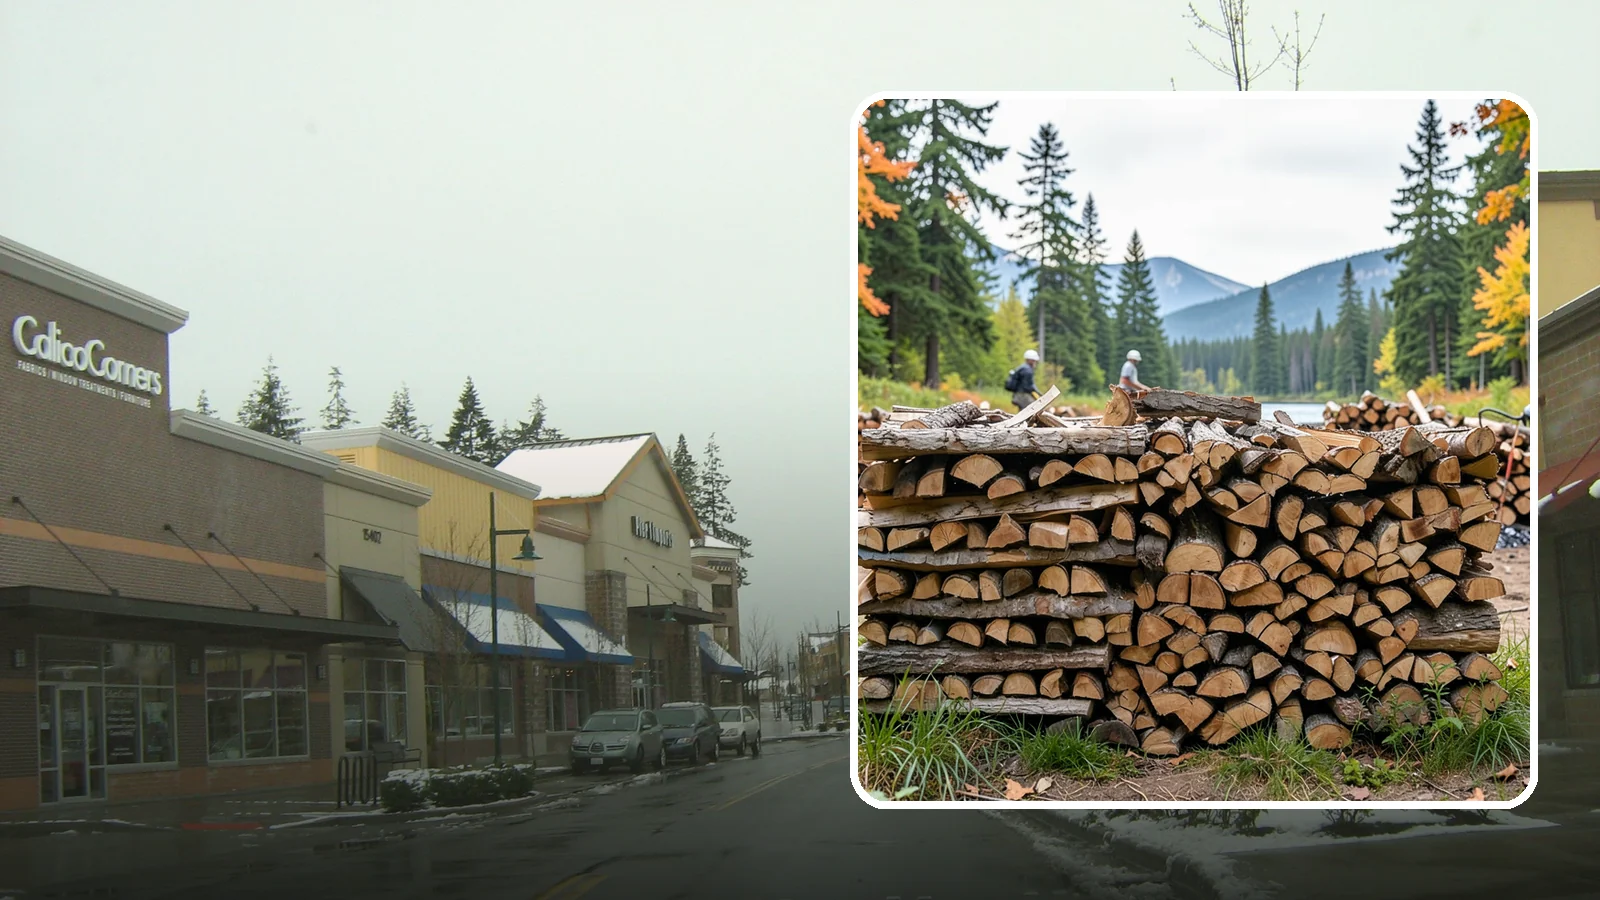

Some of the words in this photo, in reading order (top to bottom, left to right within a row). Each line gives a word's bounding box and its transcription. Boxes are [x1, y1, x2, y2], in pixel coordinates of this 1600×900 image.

[17, 360, 47, 377] FABRICS
[51, 370, 78, 386] WINDOW
[79, 378, 117, 398] TREATMENTS
[120, 391, 151, 408] FURNITURE
